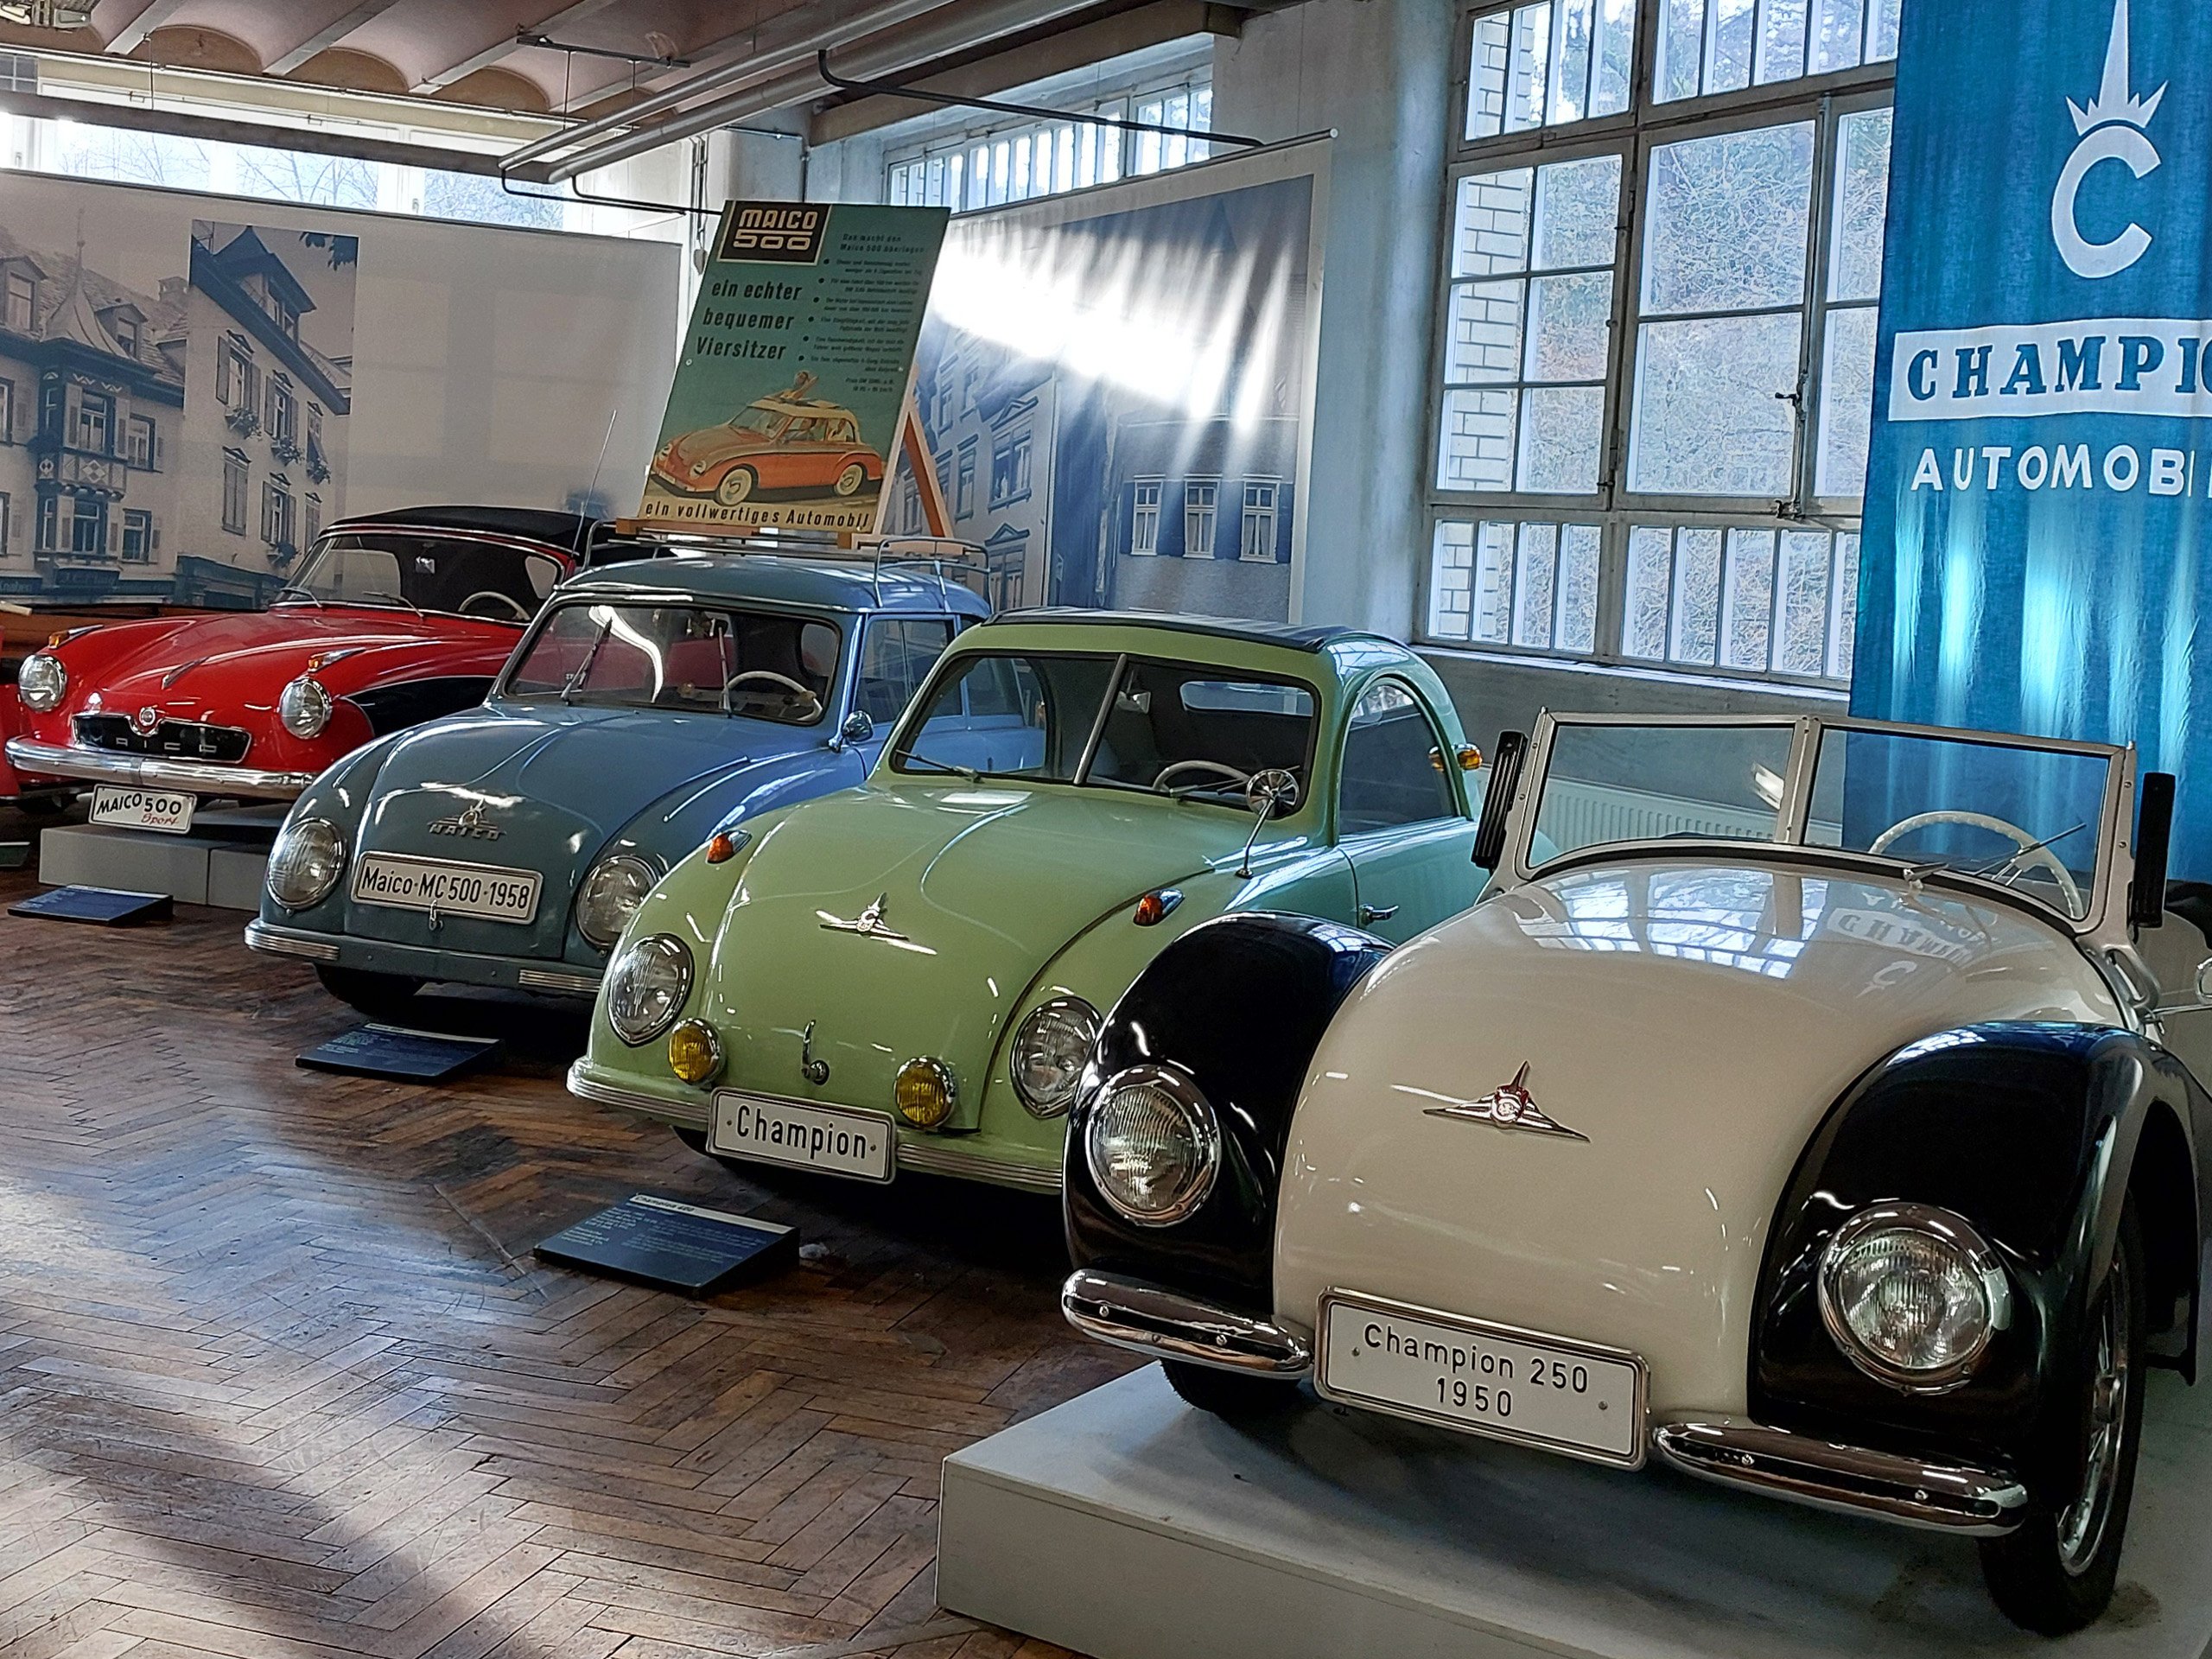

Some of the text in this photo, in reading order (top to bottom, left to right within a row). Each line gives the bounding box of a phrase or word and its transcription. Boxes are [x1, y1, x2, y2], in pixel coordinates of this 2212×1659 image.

[739, 209, 818, 229] MAICO
[733, 229, 813, 251] 500
[866, 244, 882, 252] 500
[711, 278, 803, 301] ein echter
[702, 307, 795, 330] bequemer
[696, 336, 787, 359] Viersitzer
[1907, 334, 2212, 401] CHAMPI
[1910, 443, 2212, 499] AUTOMOBI
[645, 501, 869, 528] ein vollwertiges Automobil
[96, 793, 181, 815] MAICO 500
[141, 812, 179, 825] Sport
[361, 866, 413, 895] Maico
[488, 881, 530, 908] 1958
[736, 1103, 866, 1160] Champion
[1363, 1323, 1588, 1393] Champion 250
[1436, 1376, 1512, 1417] 1950
